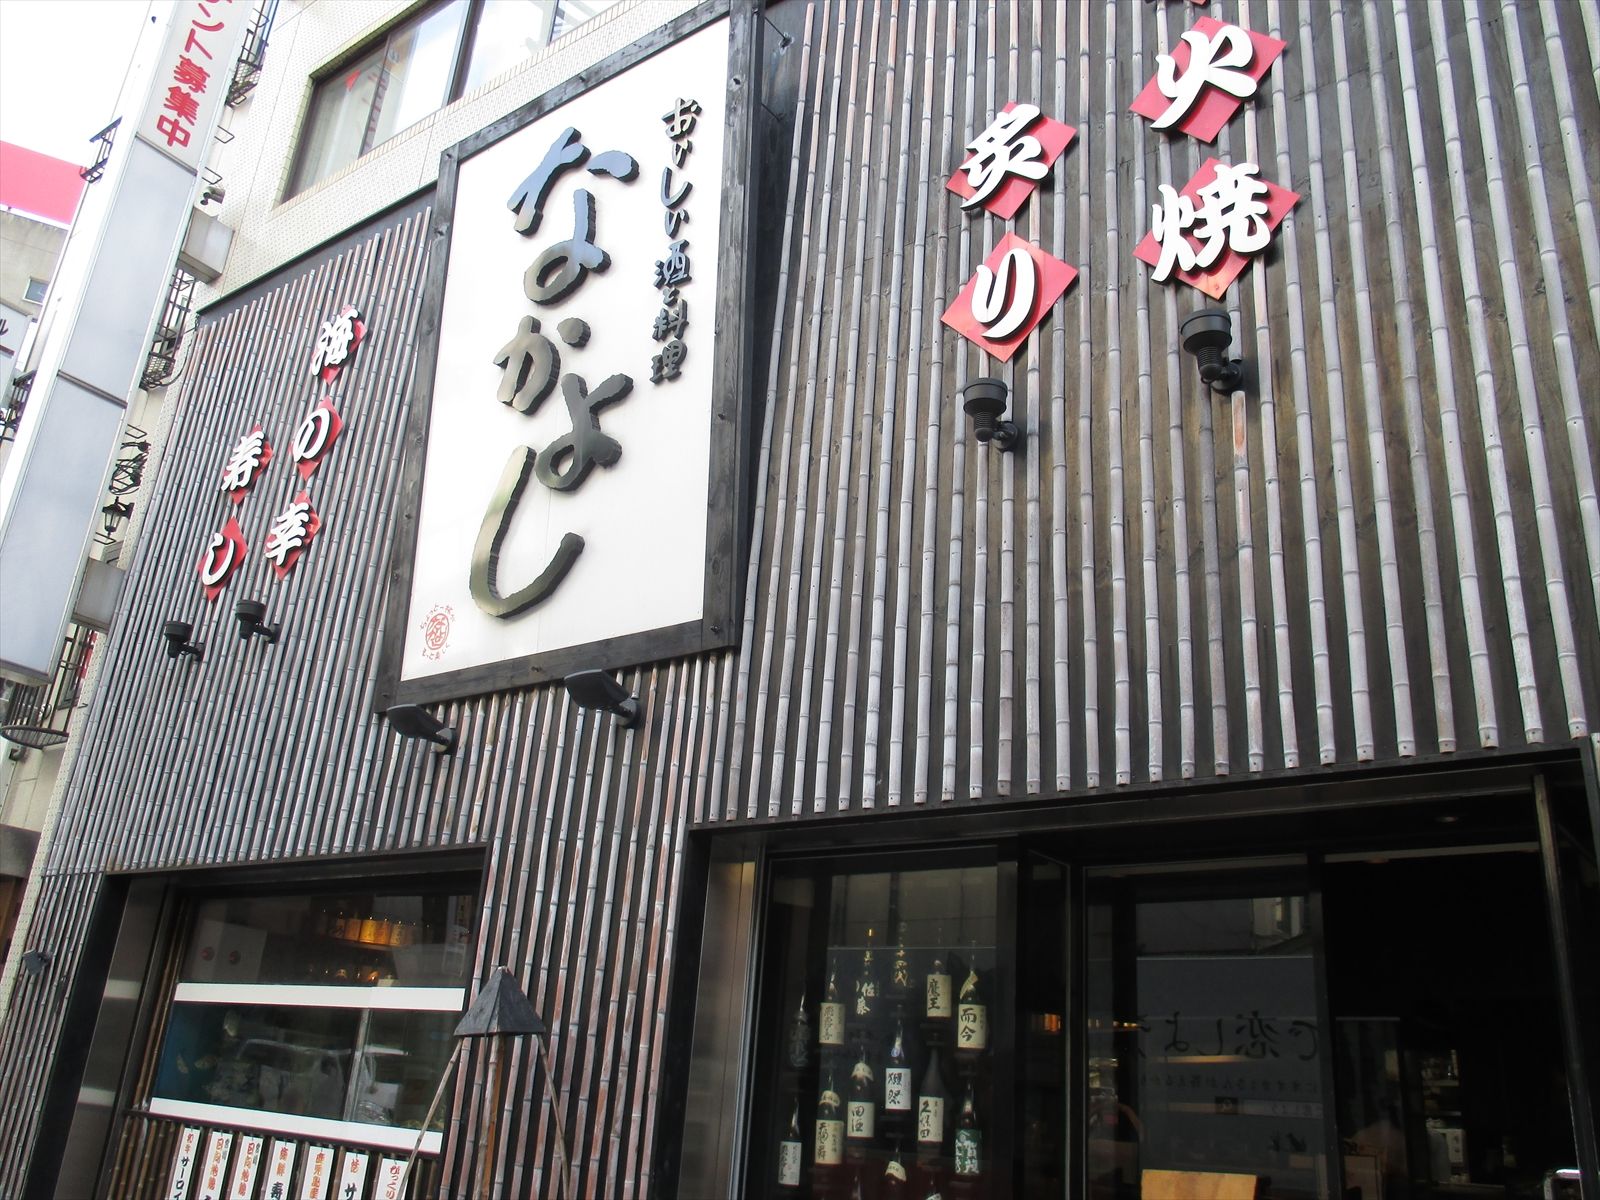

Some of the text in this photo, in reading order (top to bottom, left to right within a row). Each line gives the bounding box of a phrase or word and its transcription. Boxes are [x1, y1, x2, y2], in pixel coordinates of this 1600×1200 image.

[156, 0, 233, 148] ント募集中
[649, 97, 703, 385] おいしい酒と料理
[469, 126, 640, 620] なかよし
[264, 308, 360, 568] 海の幸
[200, 430, 266, 588] 寿し
[927, 979, 941, 1010] 魔王
[960, 1007, 978, 1042] 而今
[850, 1105, 866, 1133] 田酒
[887, 1072, 903, 1105] 獺祭
[919, 1099, 932, 1139] 久保田
